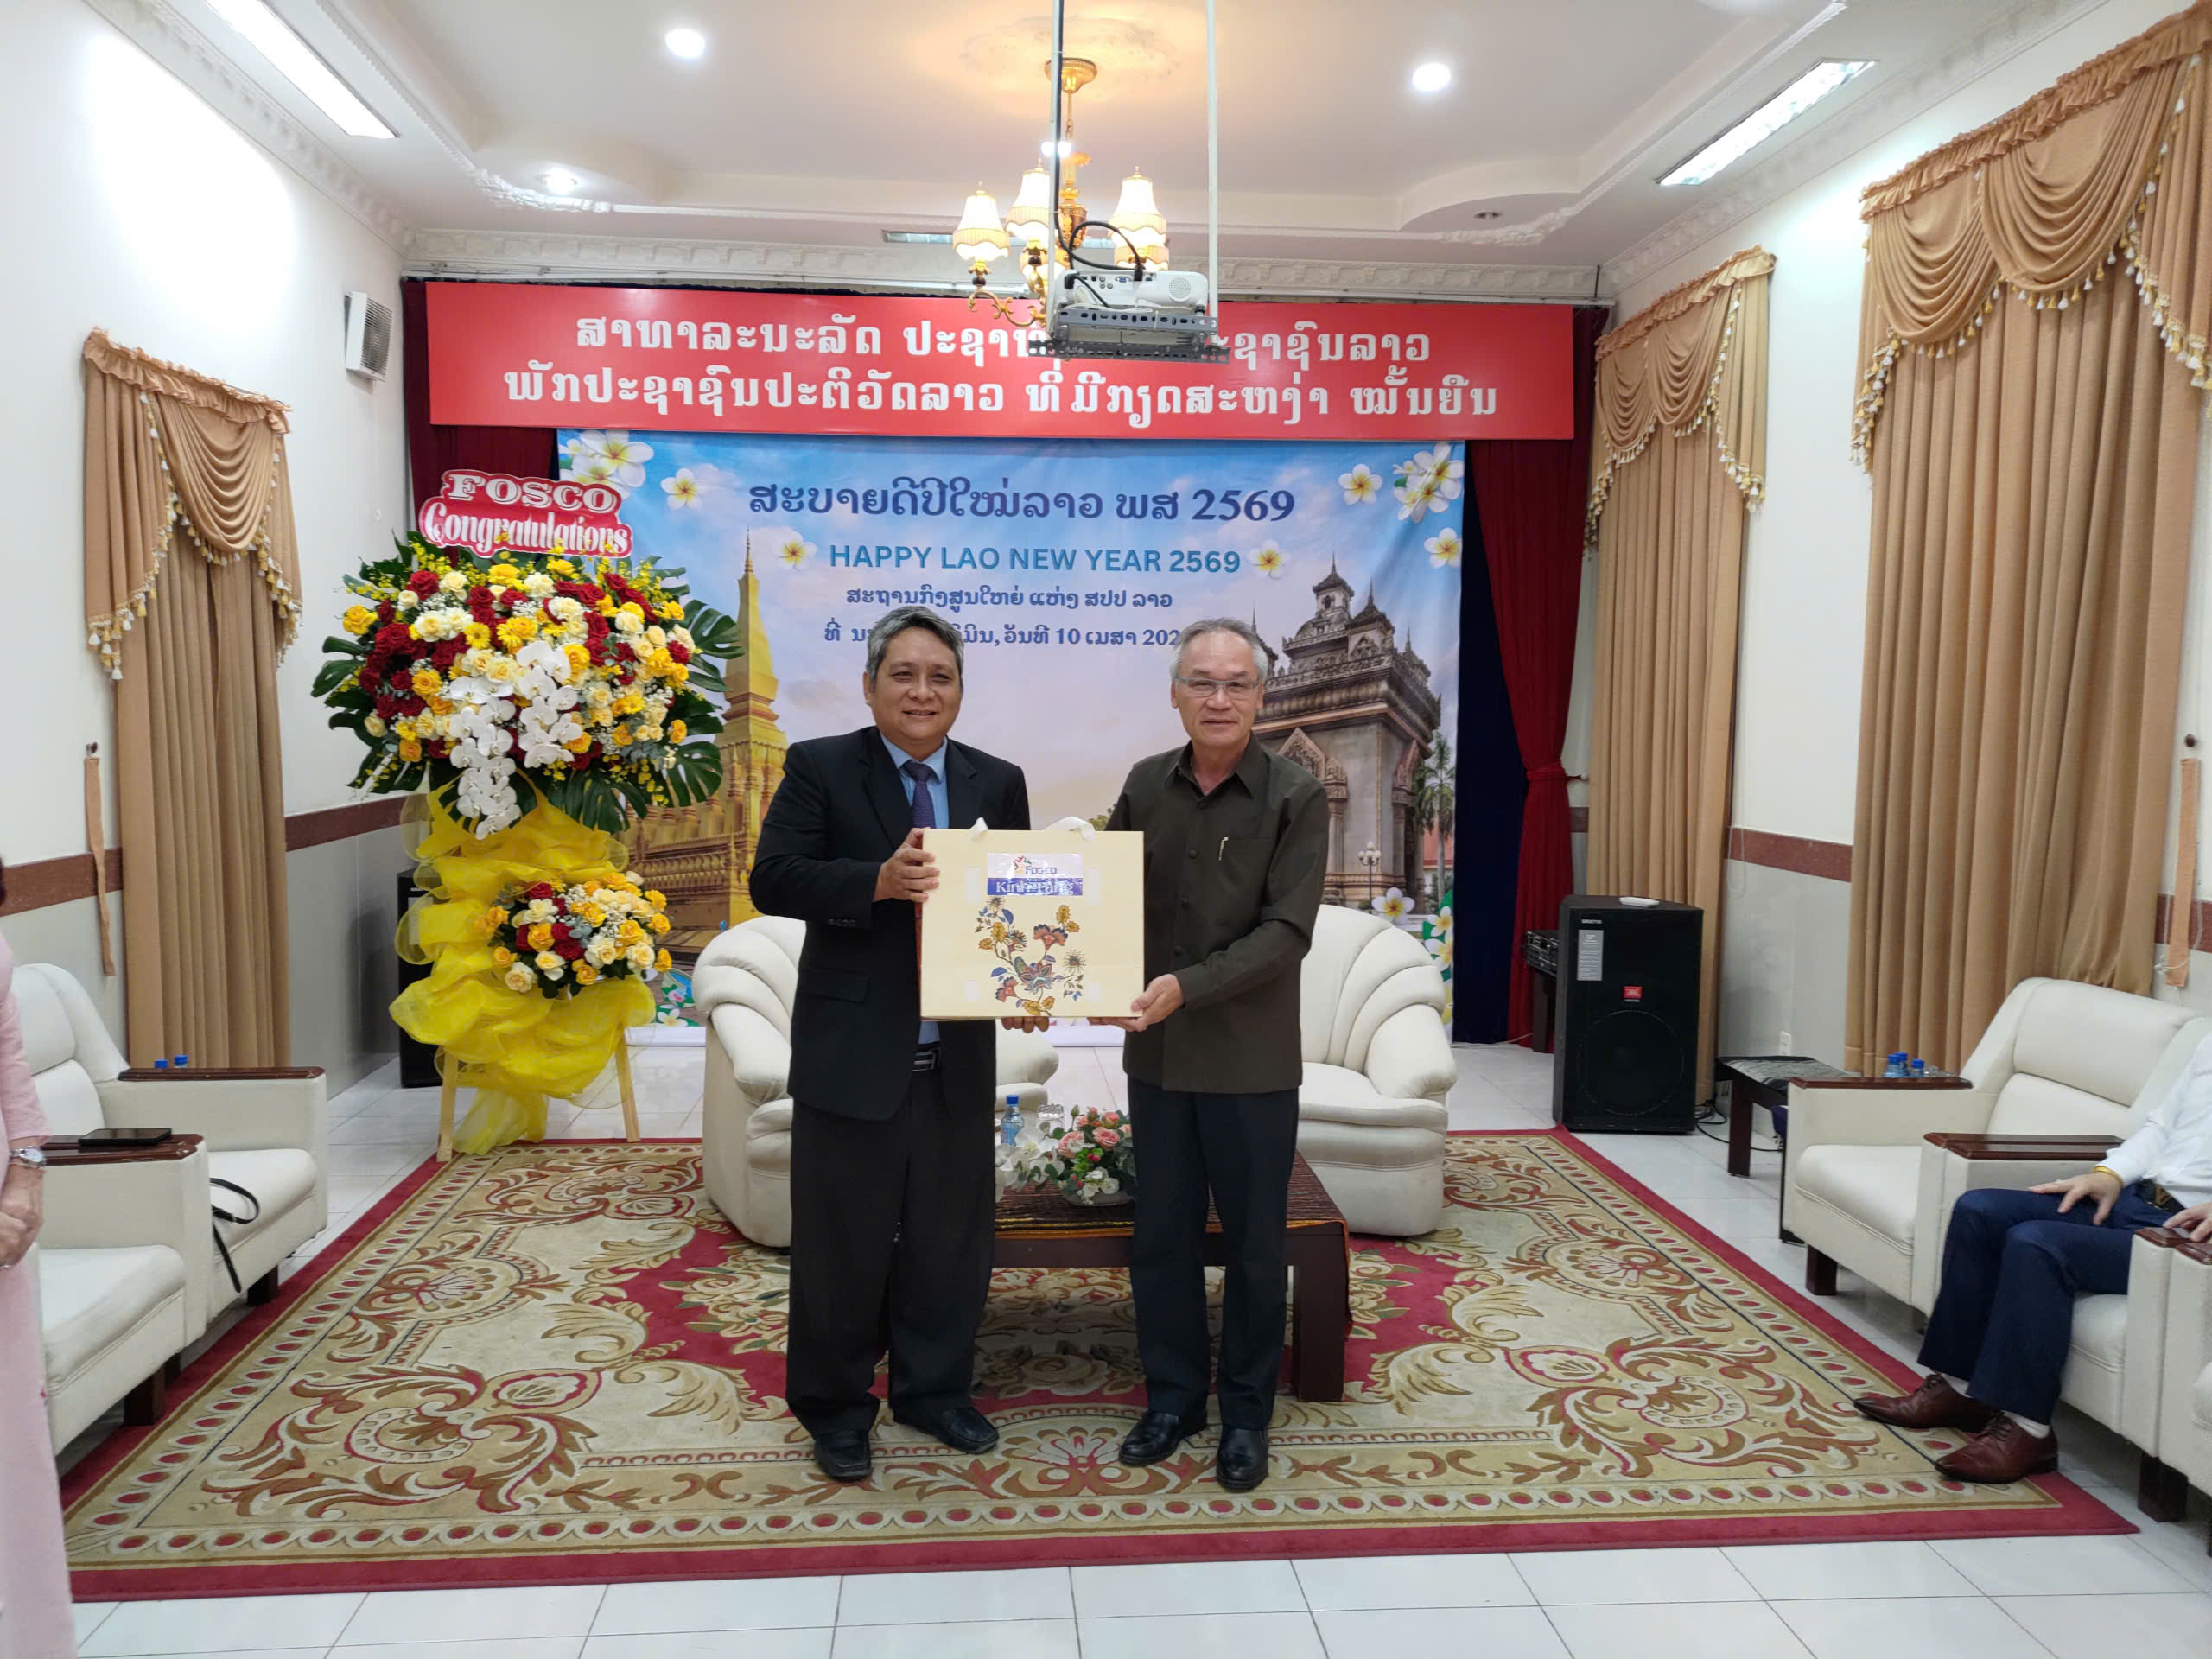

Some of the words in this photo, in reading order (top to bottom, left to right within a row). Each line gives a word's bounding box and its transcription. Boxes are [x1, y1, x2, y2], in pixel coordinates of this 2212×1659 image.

[448, 474, 617, 513] FOSCO
[1116, 491, 1179, 520] ພສ
[1192, 489, 1294, 521] 2569
[426, 502, 628, 553] Congratulations
[830, 544, 931, 568] HAPPY
[941, 547, 1000, 569] LAO
[1009, 548, 1077, 570] NEW
[1085, 550, 1161, 571] YEAR
[1169, 550, 1241, 573] 2569
[1133, 594, 1173, 607] ລາວ
[1055, 628, 1081, 644] 10
[1142, 629, 1181, 645] 202
